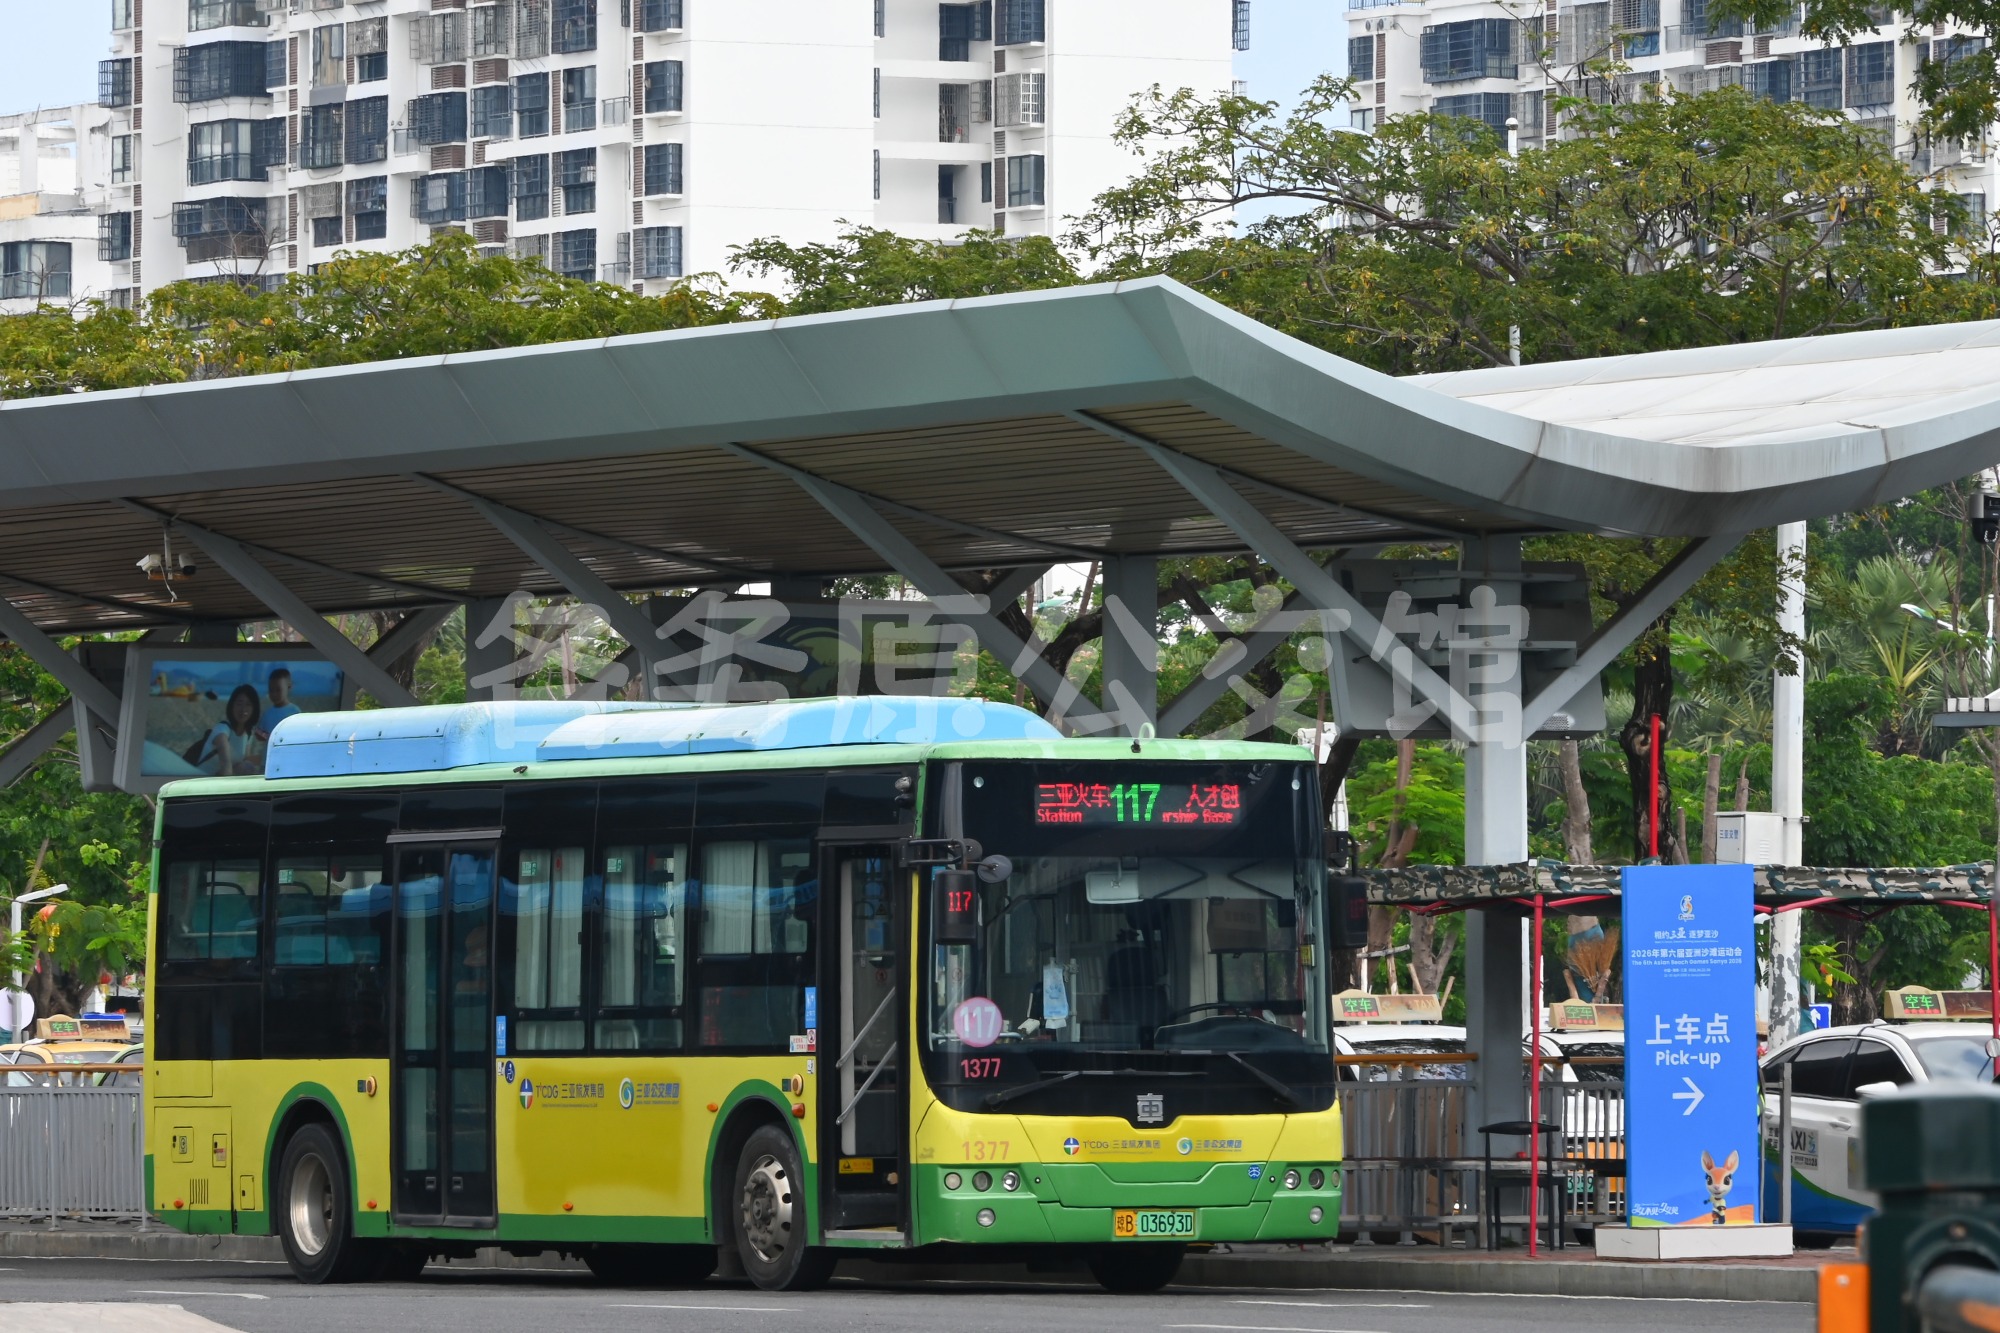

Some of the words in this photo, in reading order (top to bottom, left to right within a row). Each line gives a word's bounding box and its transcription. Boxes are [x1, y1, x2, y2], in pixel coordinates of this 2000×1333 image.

[1039, 783, 1111, 808] 三亚火车
[1111, 783, 1161, 821] 117
[1037, 808, 1083, 823] Station
[948, 891, 972, 912] 117
[1345, 998, 1373, 1012] 空车
[1905, 994, 1935, 1010] 空车
[52, 1021, 75, 1033] 空车
[959, 1006, 996, 1039] 117
[1646, 1013, 1730, 1045] 上车点
[961, 1058, 1001, 1078] 1377
[1656, 1050, 1721, 1069] Pick-up
[636, 1083, 680, 1099] 三亚公交集团
[962, 1140, 1010, 1161] 1377
[1141, 1214, 1193, 1233] 03693D
